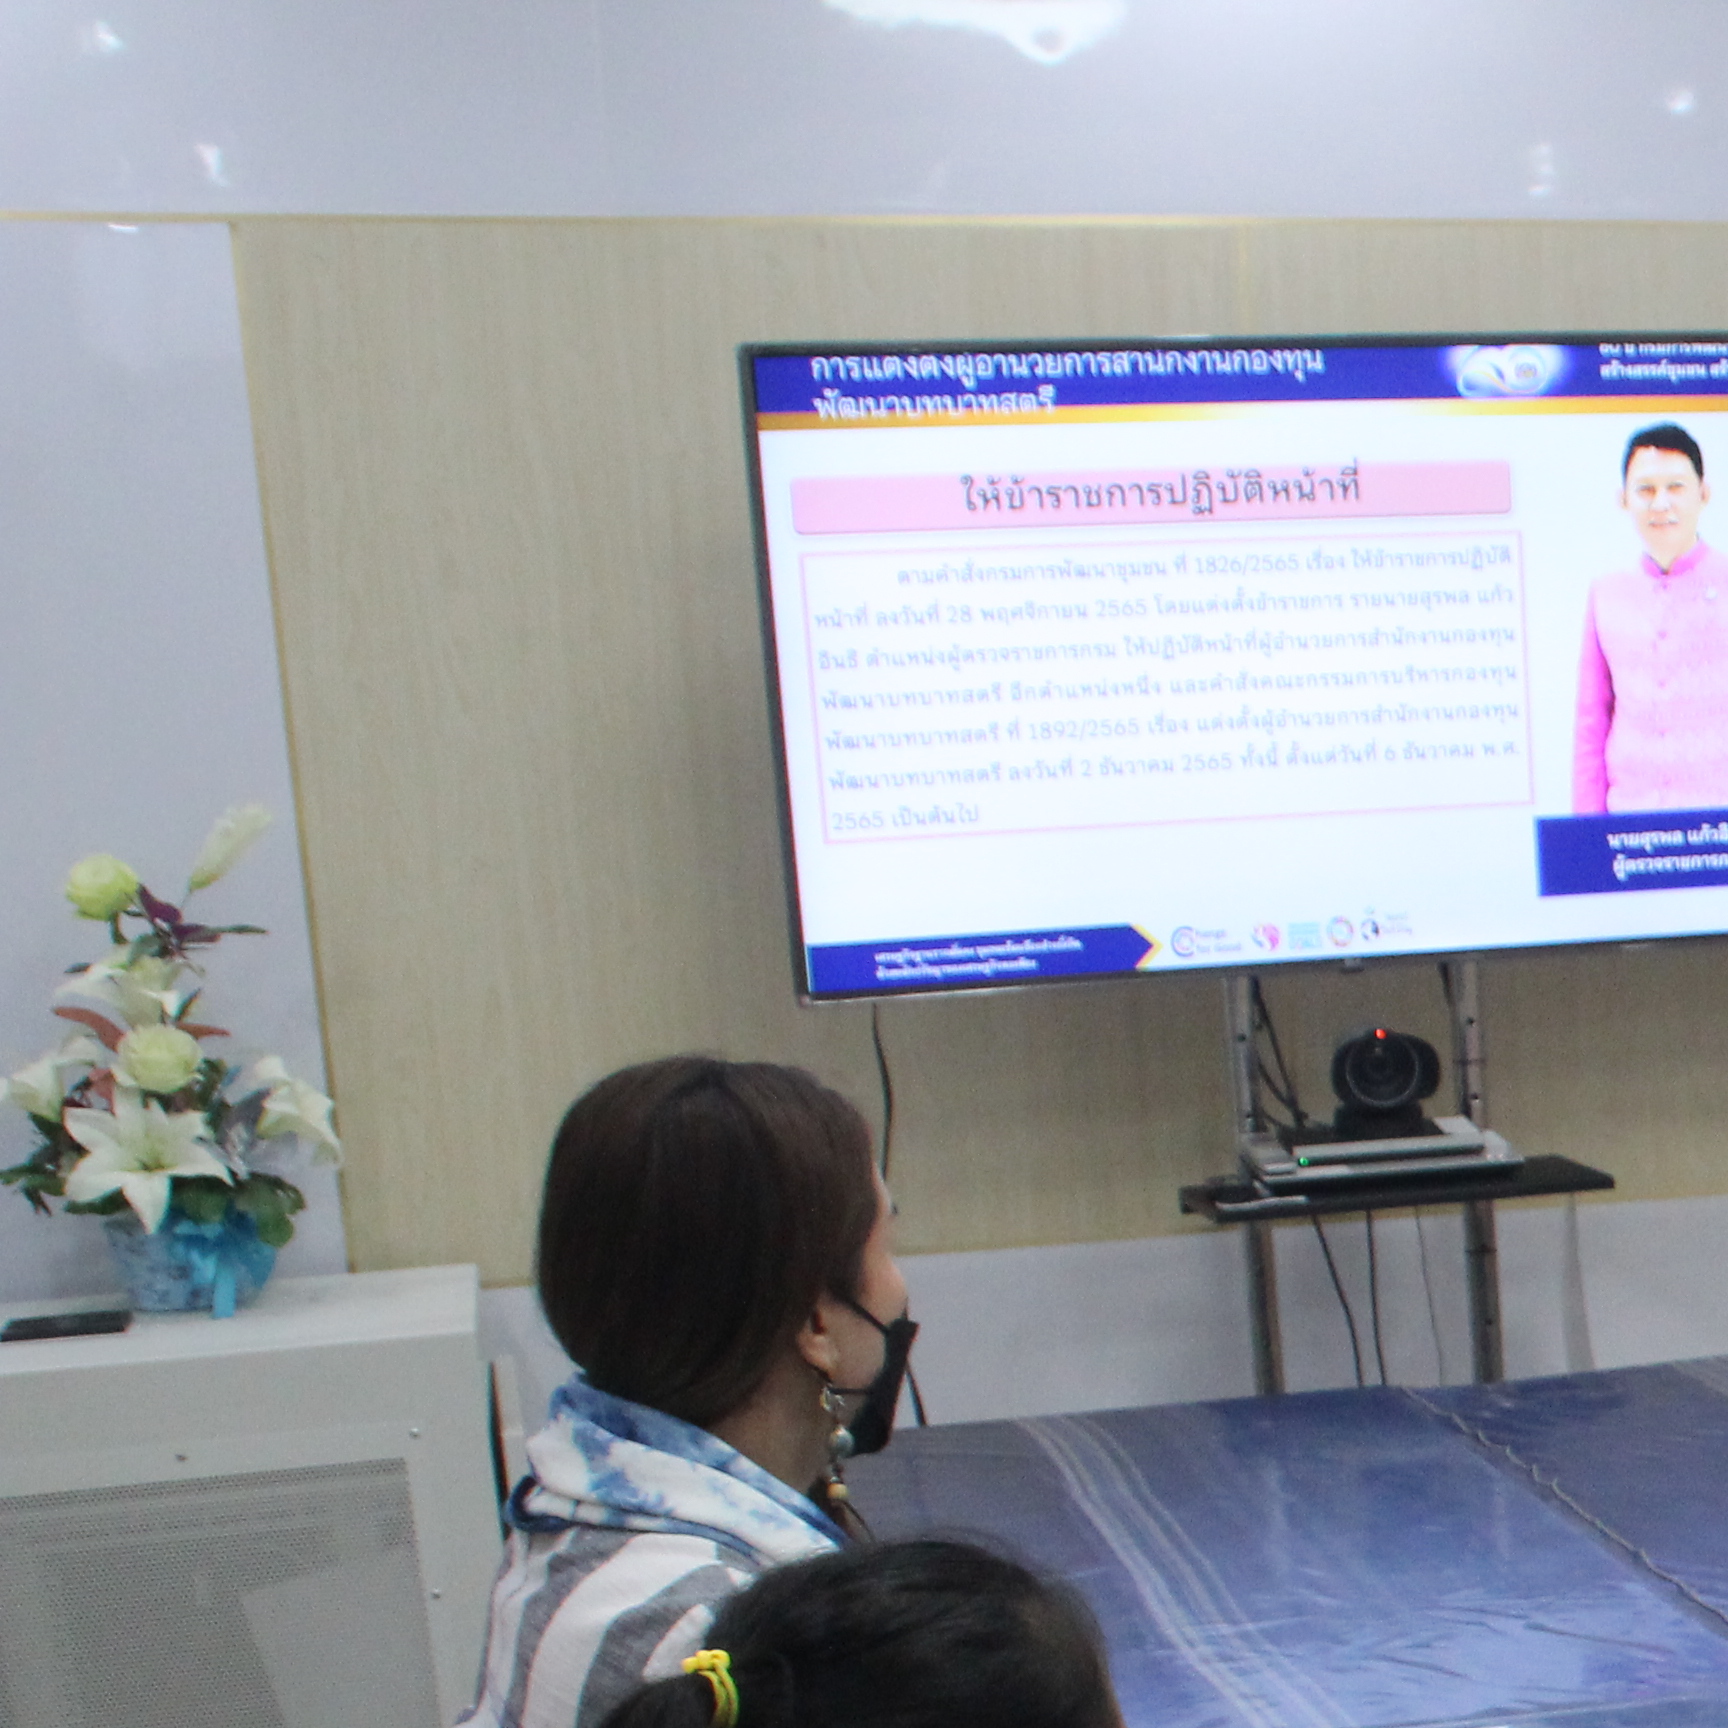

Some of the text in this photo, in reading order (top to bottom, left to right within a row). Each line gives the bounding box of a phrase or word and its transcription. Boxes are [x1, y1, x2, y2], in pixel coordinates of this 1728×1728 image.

[812, 384, 1057, 420] พัฒนาบทบาทสตรี
[960, 457, 1361, 515] ให้ข้าราชการปฏิบัติหน้าที่
[1194, 553, 1300, 576] 1826/2565
[946, 604, 973, 625] 28
[1095, 599, 1148, 619] 2565
[1081, 758, 1092, 779] 2
[1181, 752, 1233, 774] 2565
[831, 810, 885, 832] 2565
